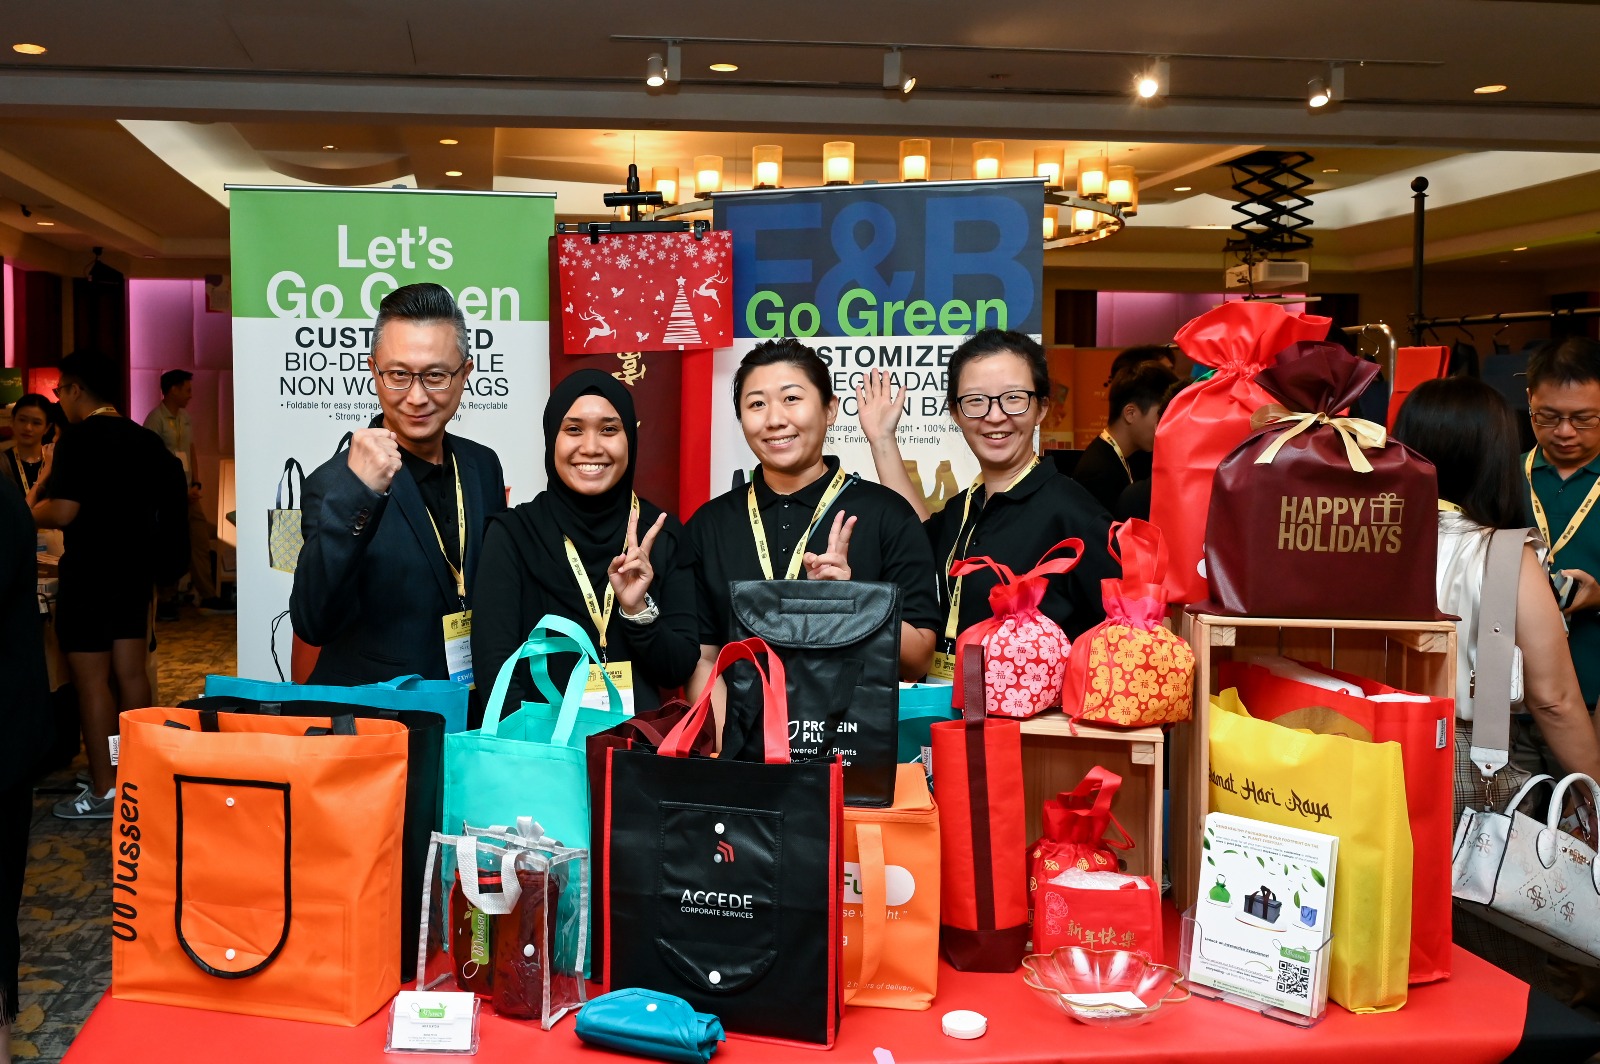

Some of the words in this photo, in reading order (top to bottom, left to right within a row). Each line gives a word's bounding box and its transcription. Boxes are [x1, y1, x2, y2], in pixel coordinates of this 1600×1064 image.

[337, 224, 454, 270] Let's
[726, 195, 1035, 338] F&B
[266, 271, 344, 320] Go
[360, 272, 520, 321] Gen
[745, 290, 821, 338] Go
[837, 288, 1008, 337] Green
[295, 326, 494, 349] CUSTD
[285, 352, 504, 372] BIO-DELE
[816, 345, 954, 368] STOMIZE
[280, 376, 334, 396] NON
[463, 377, 509, 397] AGS
[286, 401, 319, 410] Foldable
[321, 401, 332, 409] for
[334, 403, 352, 411] easy
[354, 402, 382, 411] storage
[468, 402, 508, 411] Recyclable
[336, 412, 360, 422] Strong
[923, 424, 946, 432] 100%
[909, 435, 941, 445] Friendly
[1280, 495, 1366, 526] HAPPY
[1277, 522, 1402, 554] HOLIDAYS
[803, 720, 858, 733] PROEIN
[803, 732, 824, 743] PLU
[789, 746, 818, 755] owered
[832, 748, 857, 756] Plants
[680, 889, 753, 910] ACCEDE
[680, 906, 720, 916] CORPORATE
[722, 910, 754, 919] SERVICES
